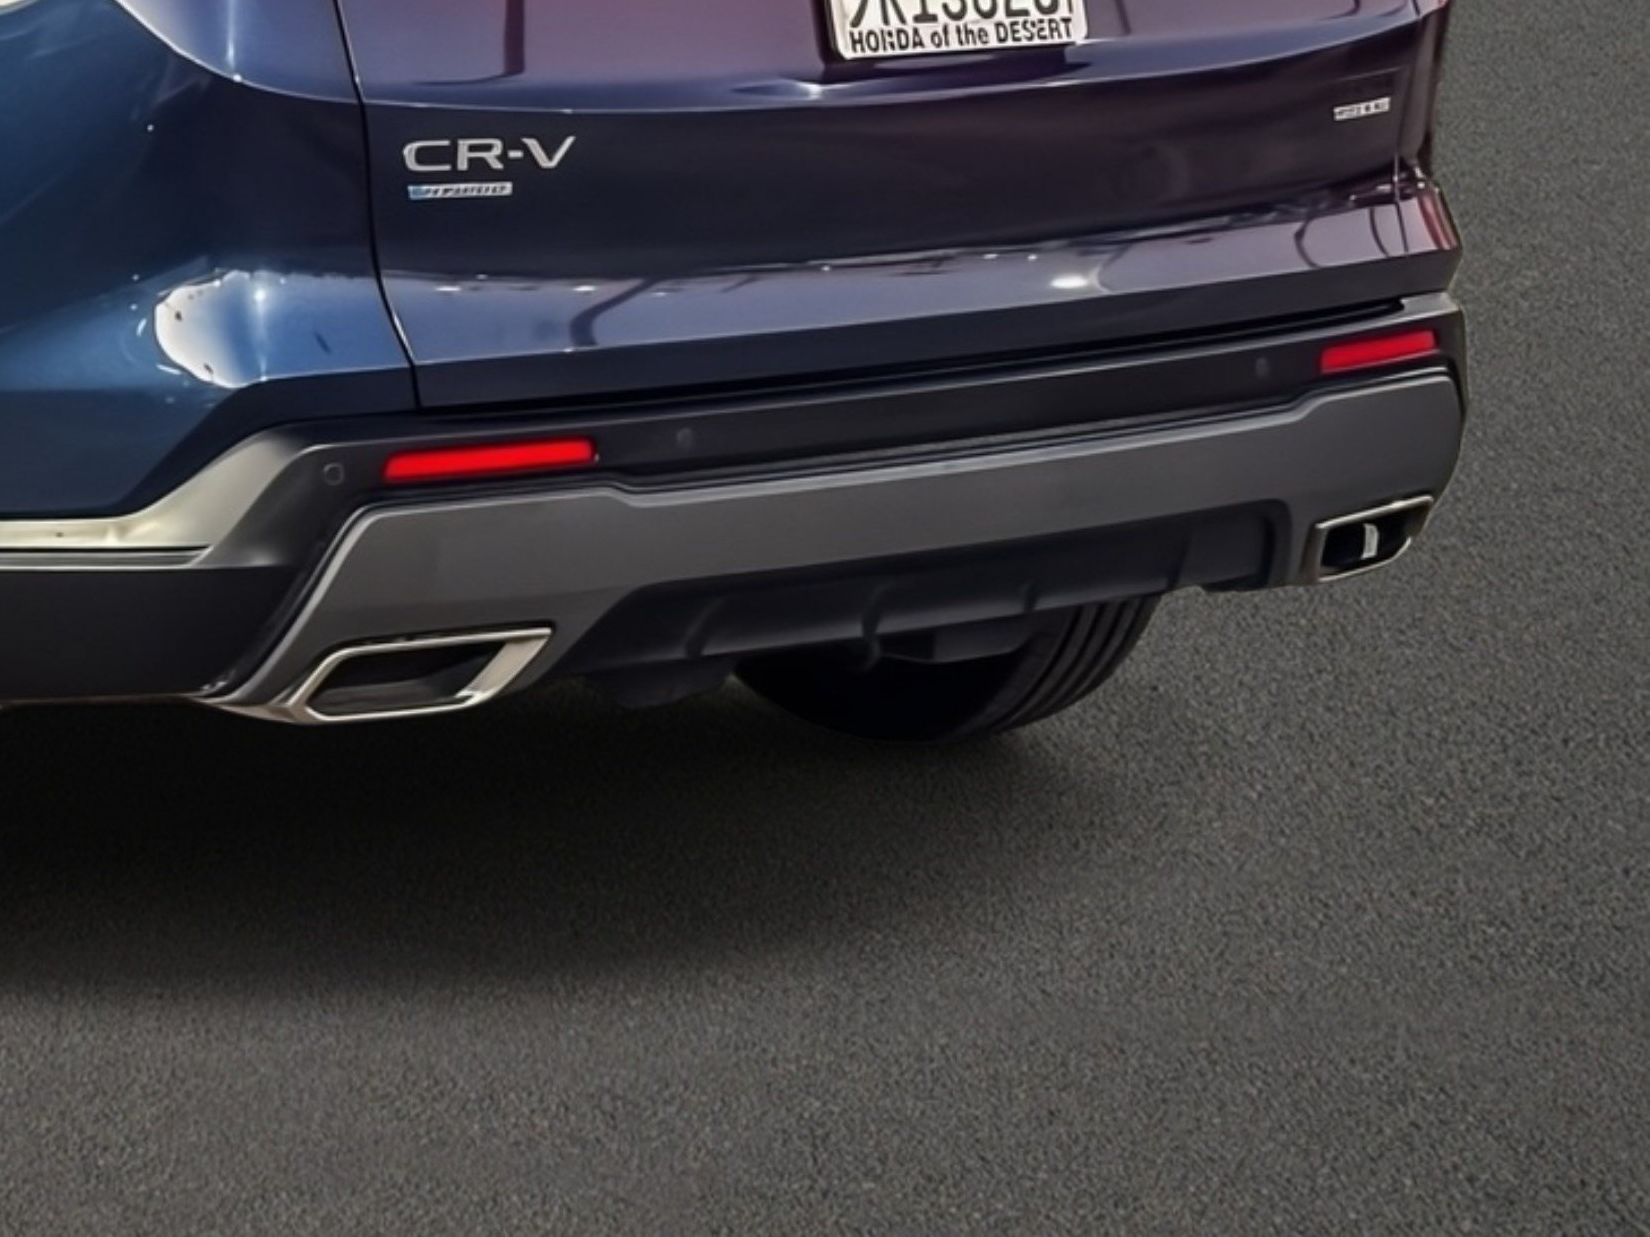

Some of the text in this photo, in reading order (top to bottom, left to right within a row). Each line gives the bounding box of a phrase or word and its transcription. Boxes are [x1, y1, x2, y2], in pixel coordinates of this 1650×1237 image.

[850, 18, 1073, 53] HONDA of the DESERT
[402, 135, 577, 172] CR-V
